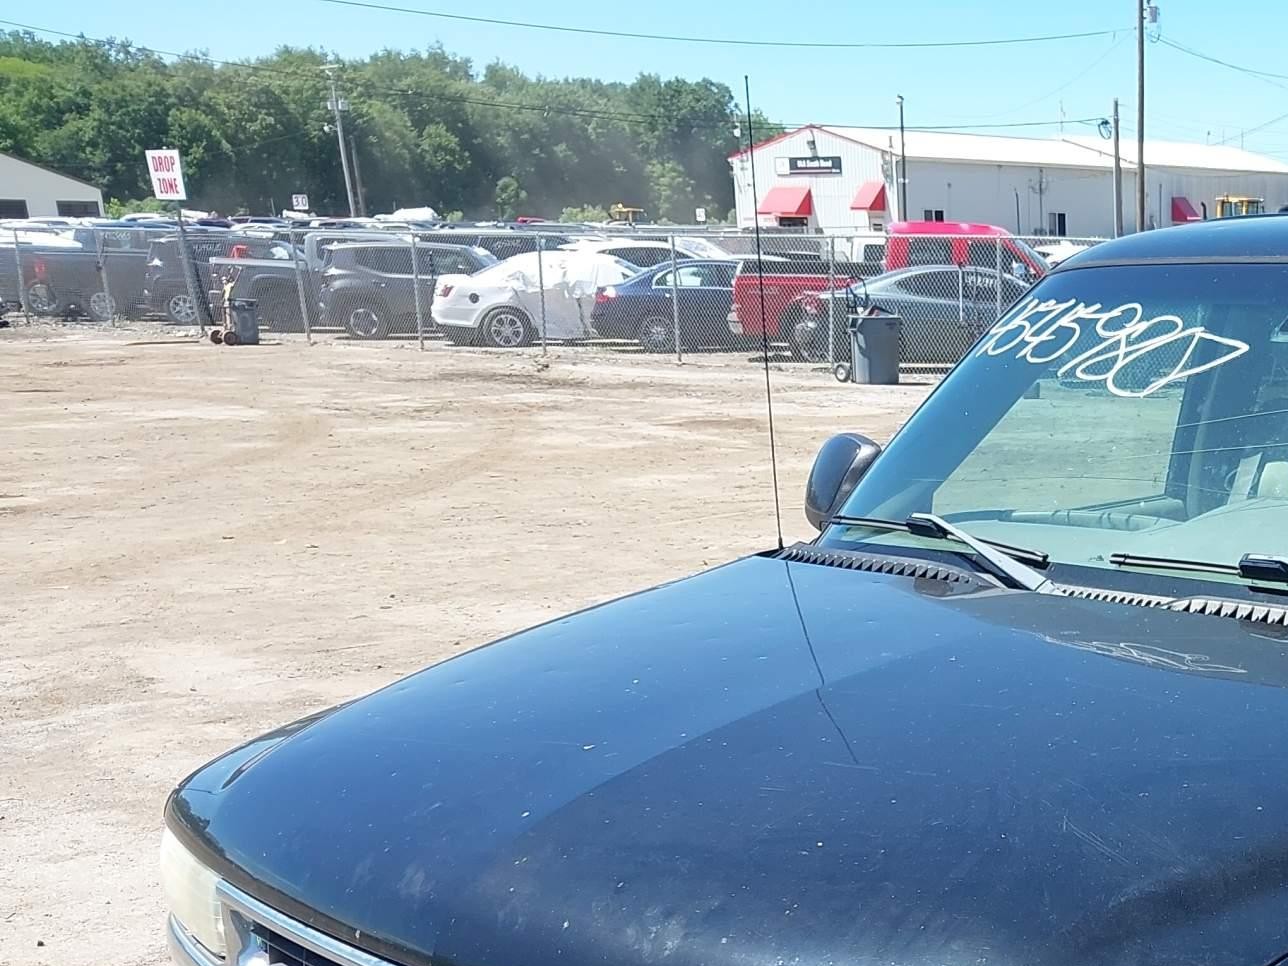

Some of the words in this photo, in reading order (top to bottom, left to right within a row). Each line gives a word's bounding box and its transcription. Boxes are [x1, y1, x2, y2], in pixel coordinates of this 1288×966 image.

[151, 155, 176, 173] DROP
[157, 178, 180, 195] ZONE
[293, 196, 308, 207] 30
